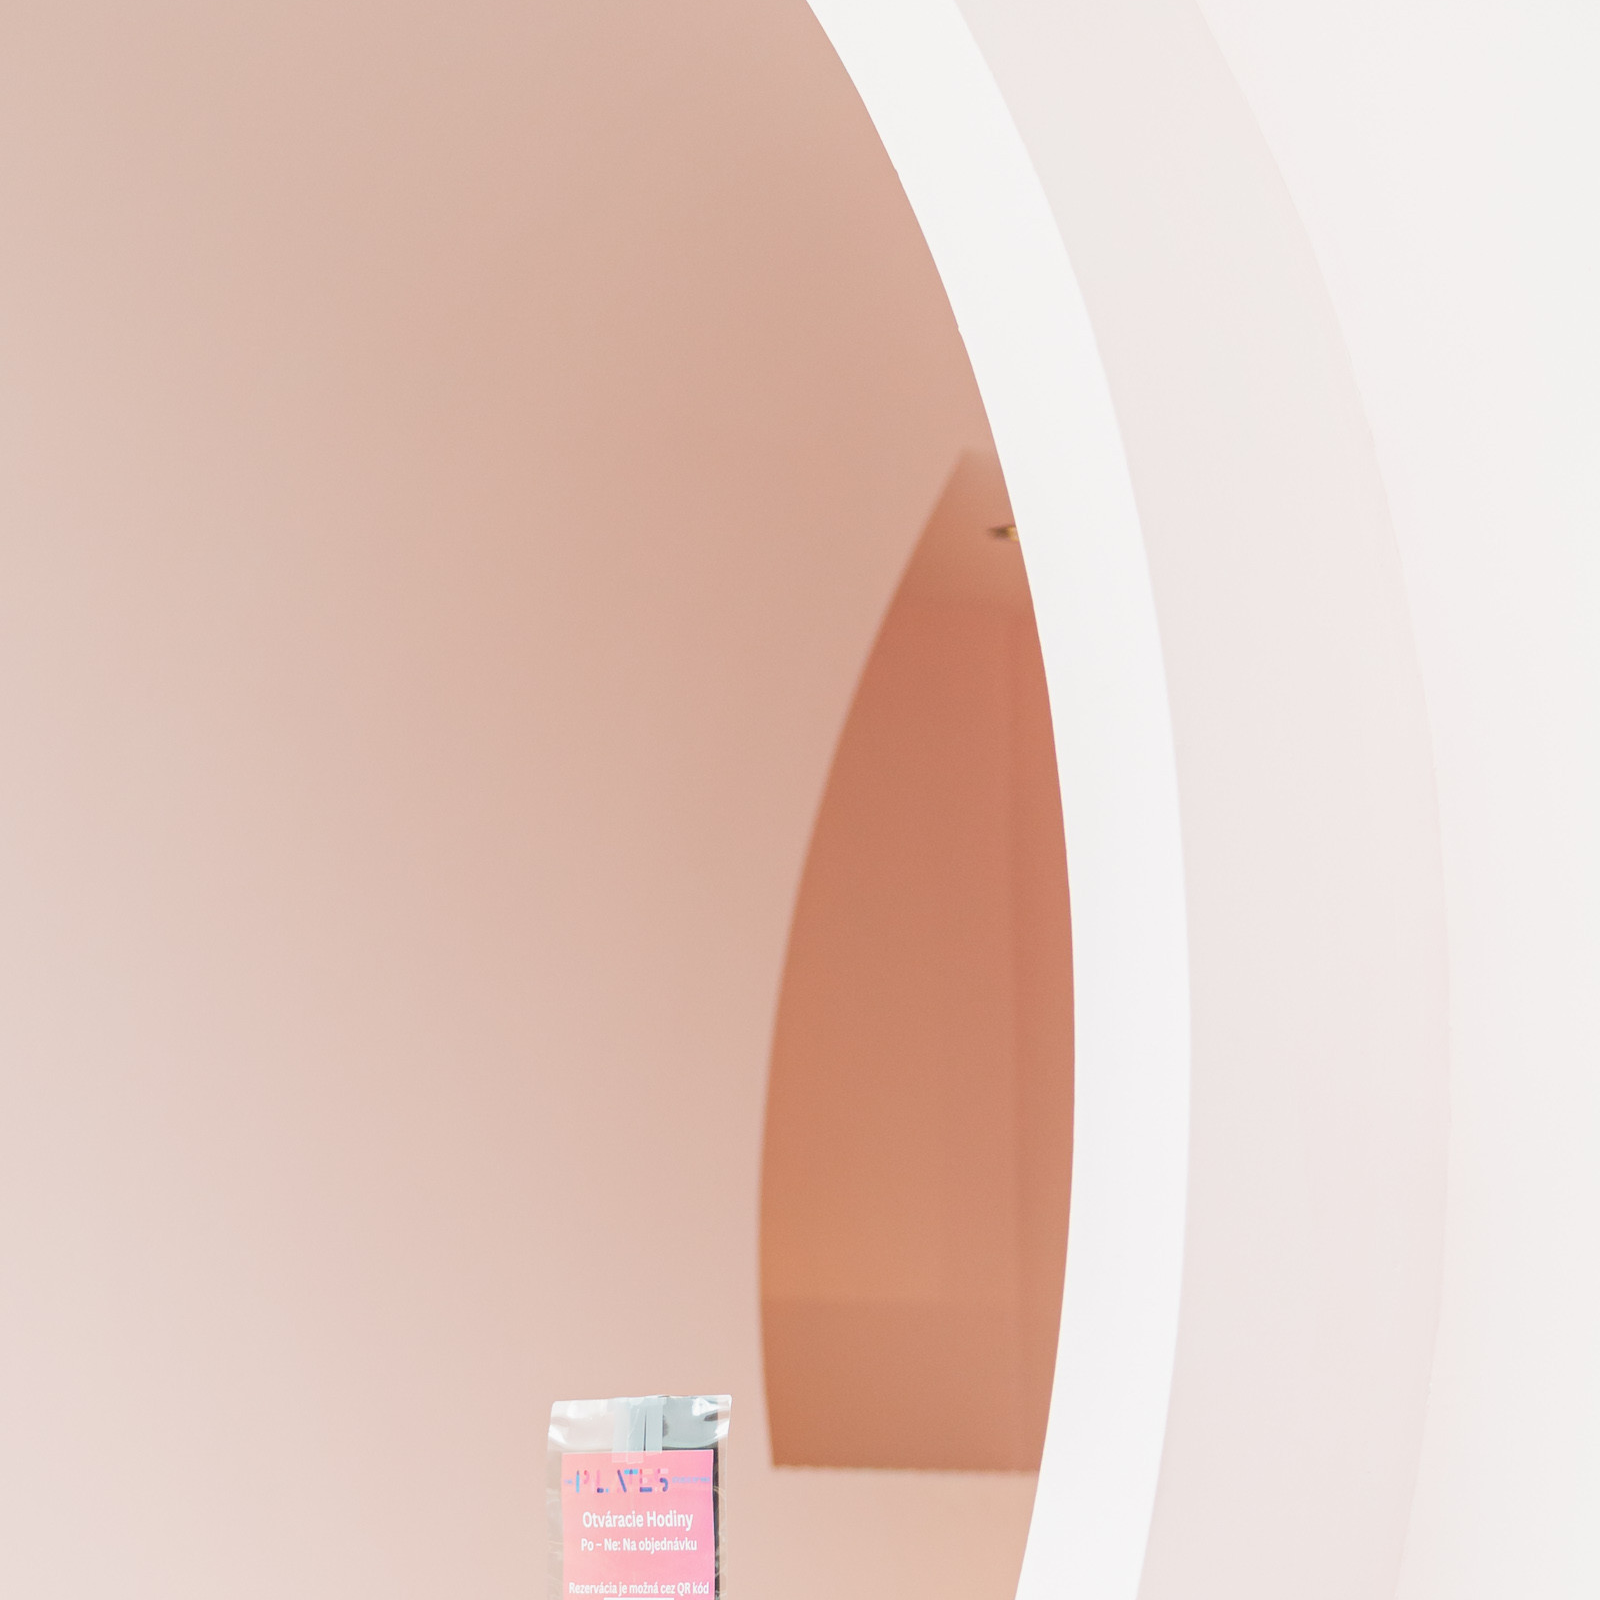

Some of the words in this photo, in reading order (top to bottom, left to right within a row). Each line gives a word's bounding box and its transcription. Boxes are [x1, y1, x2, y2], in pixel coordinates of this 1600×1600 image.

[582, 1510, 644, 1528] Otváracie
[646, 1510, 693, 1531] Hodiny
[581, 1538, 594, 1551] Po
[604, 1538, 621, 1551] Ne:
[623, 1538, 637, 1551] Na
[639, 1537, 697, 1554] objednávku
[568, 1582, 617, 1594] Rezervácia
[618, 1582, 628, 1597] je
[629, 1581, 659, 1594] možná
[660, 1585, 675, 1594] cez
[677, 1582, 691, 1595] QR
[692, 1581, 709, 1594] kód
